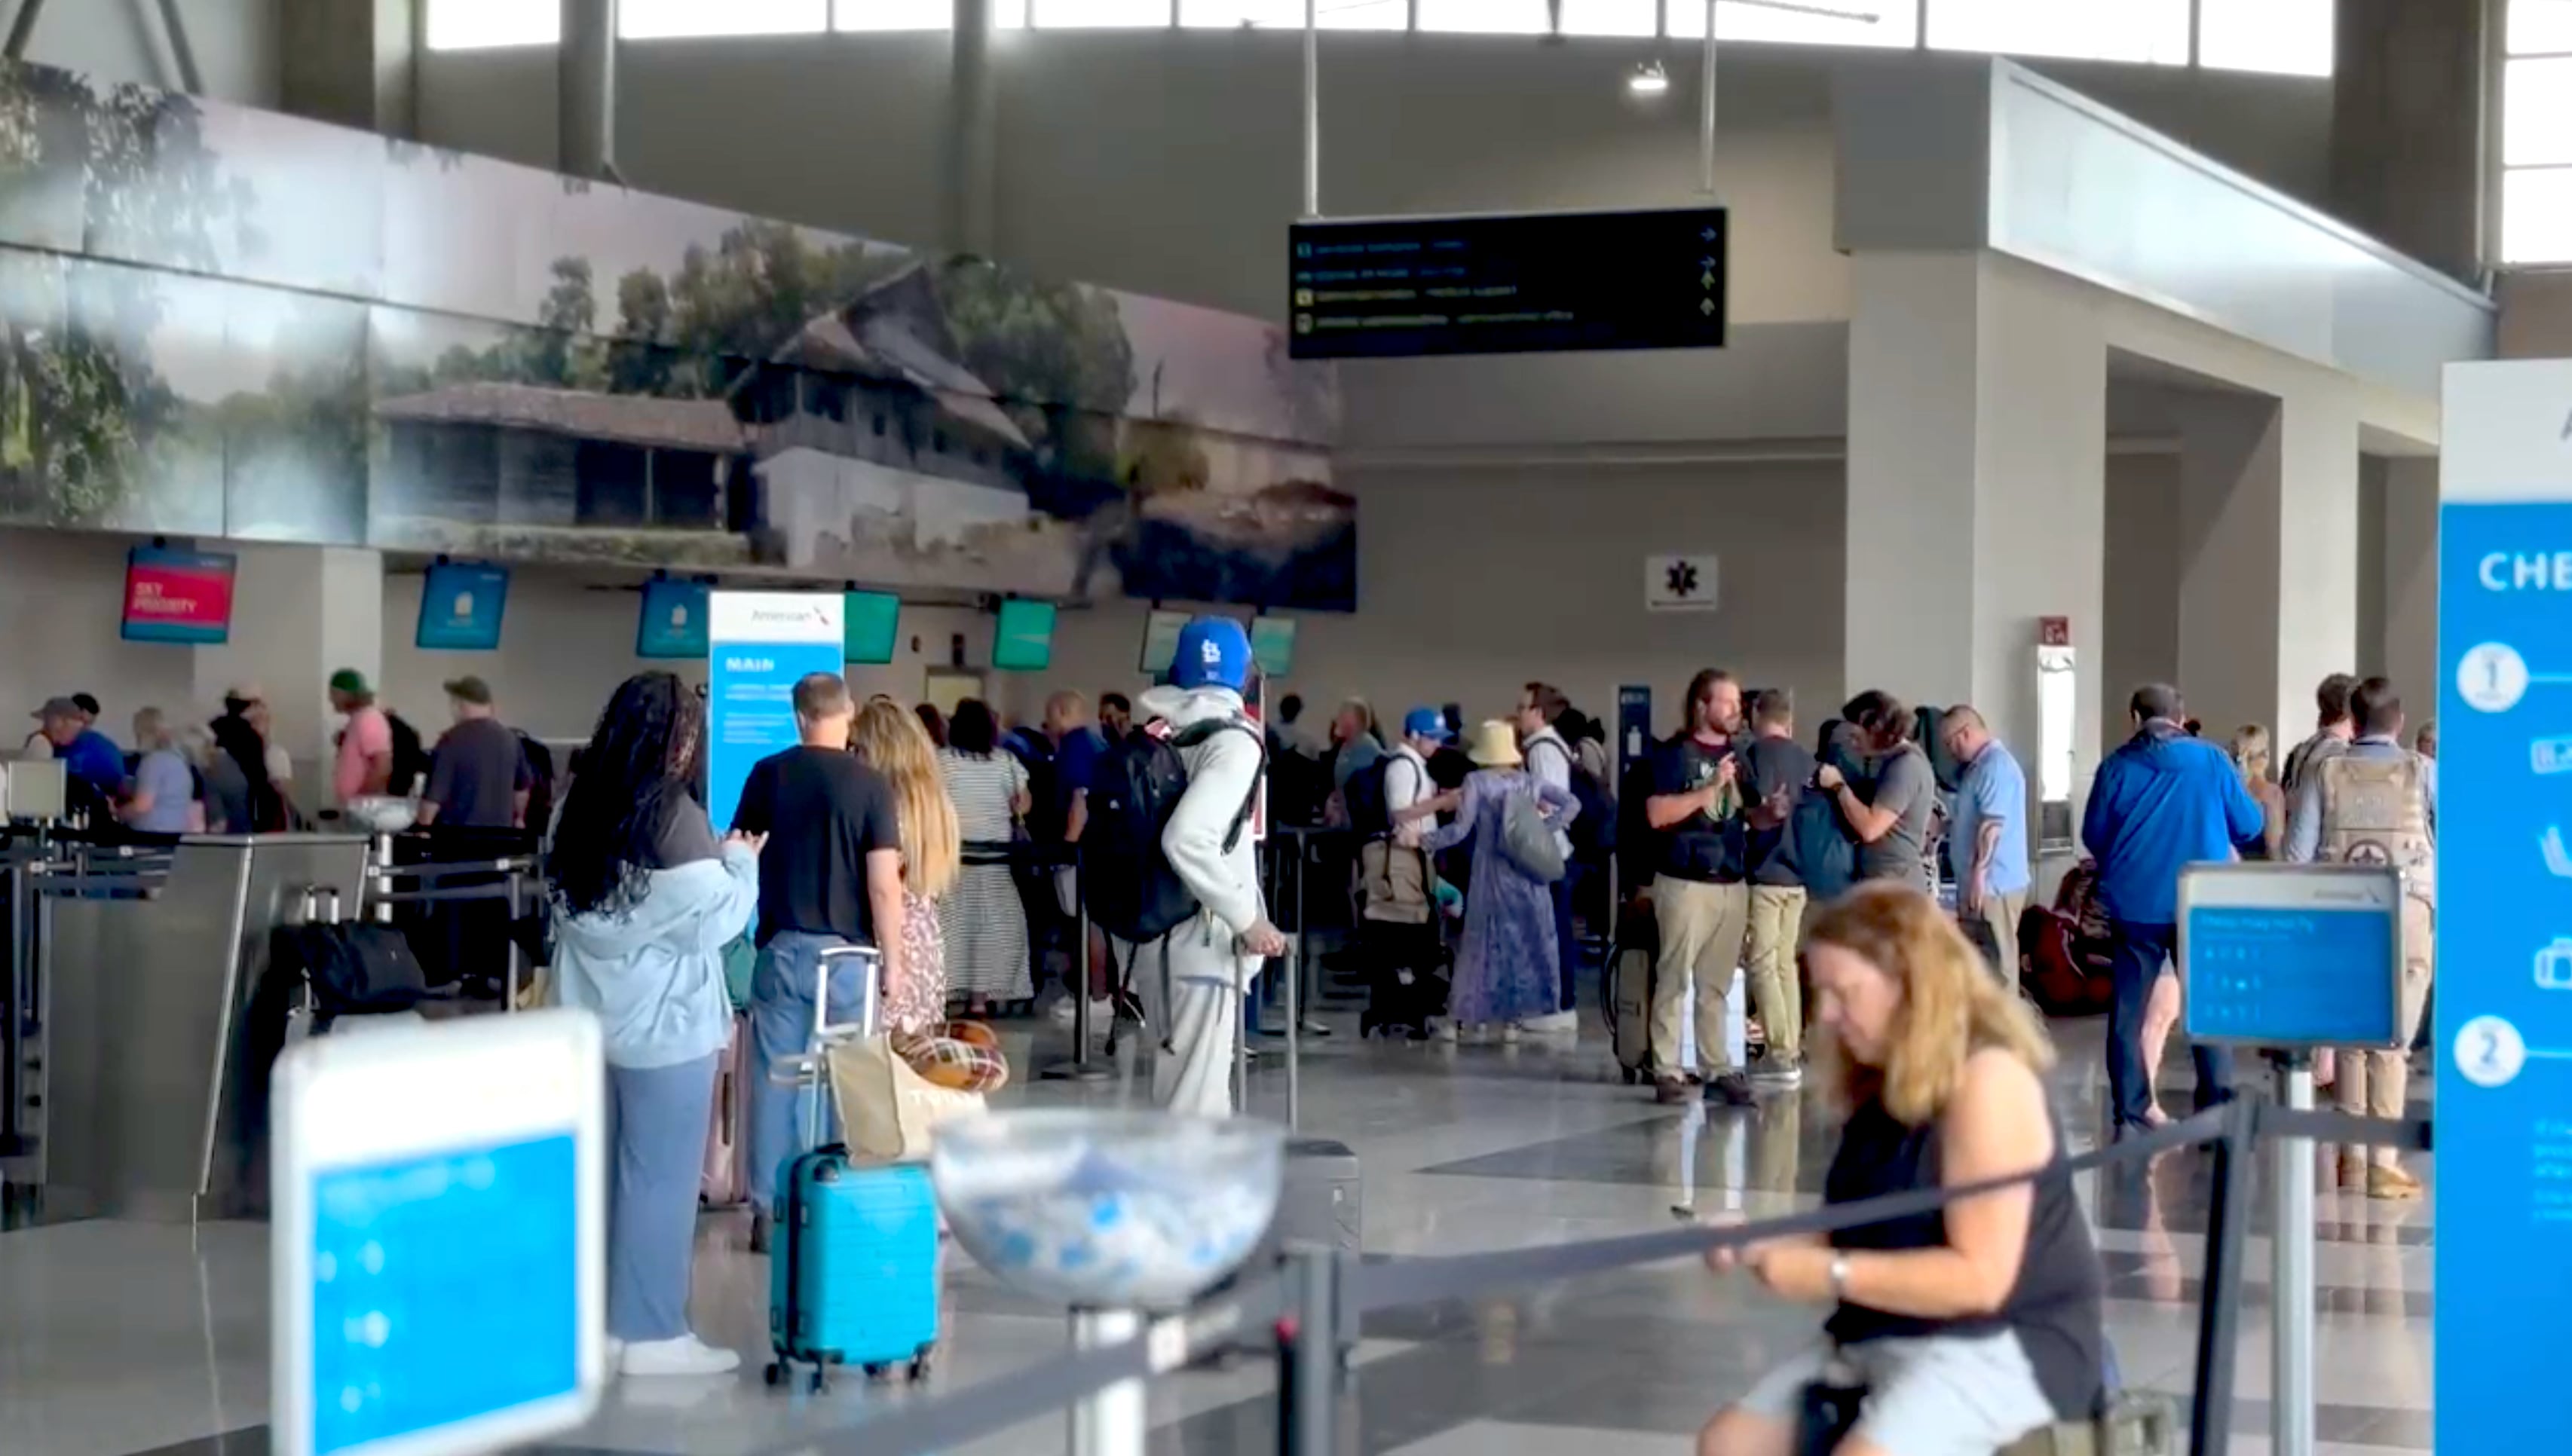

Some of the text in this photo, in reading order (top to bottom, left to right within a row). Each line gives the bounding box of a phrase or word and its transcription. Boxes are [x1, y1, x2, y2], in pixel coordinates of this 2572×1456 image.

[2479, 552, 2572, 591] CHE
[135, 582, 164, 595] SKY
[724, 656, 775, 672] MAIN
[2479, 1030, 2499, 1064] 2
